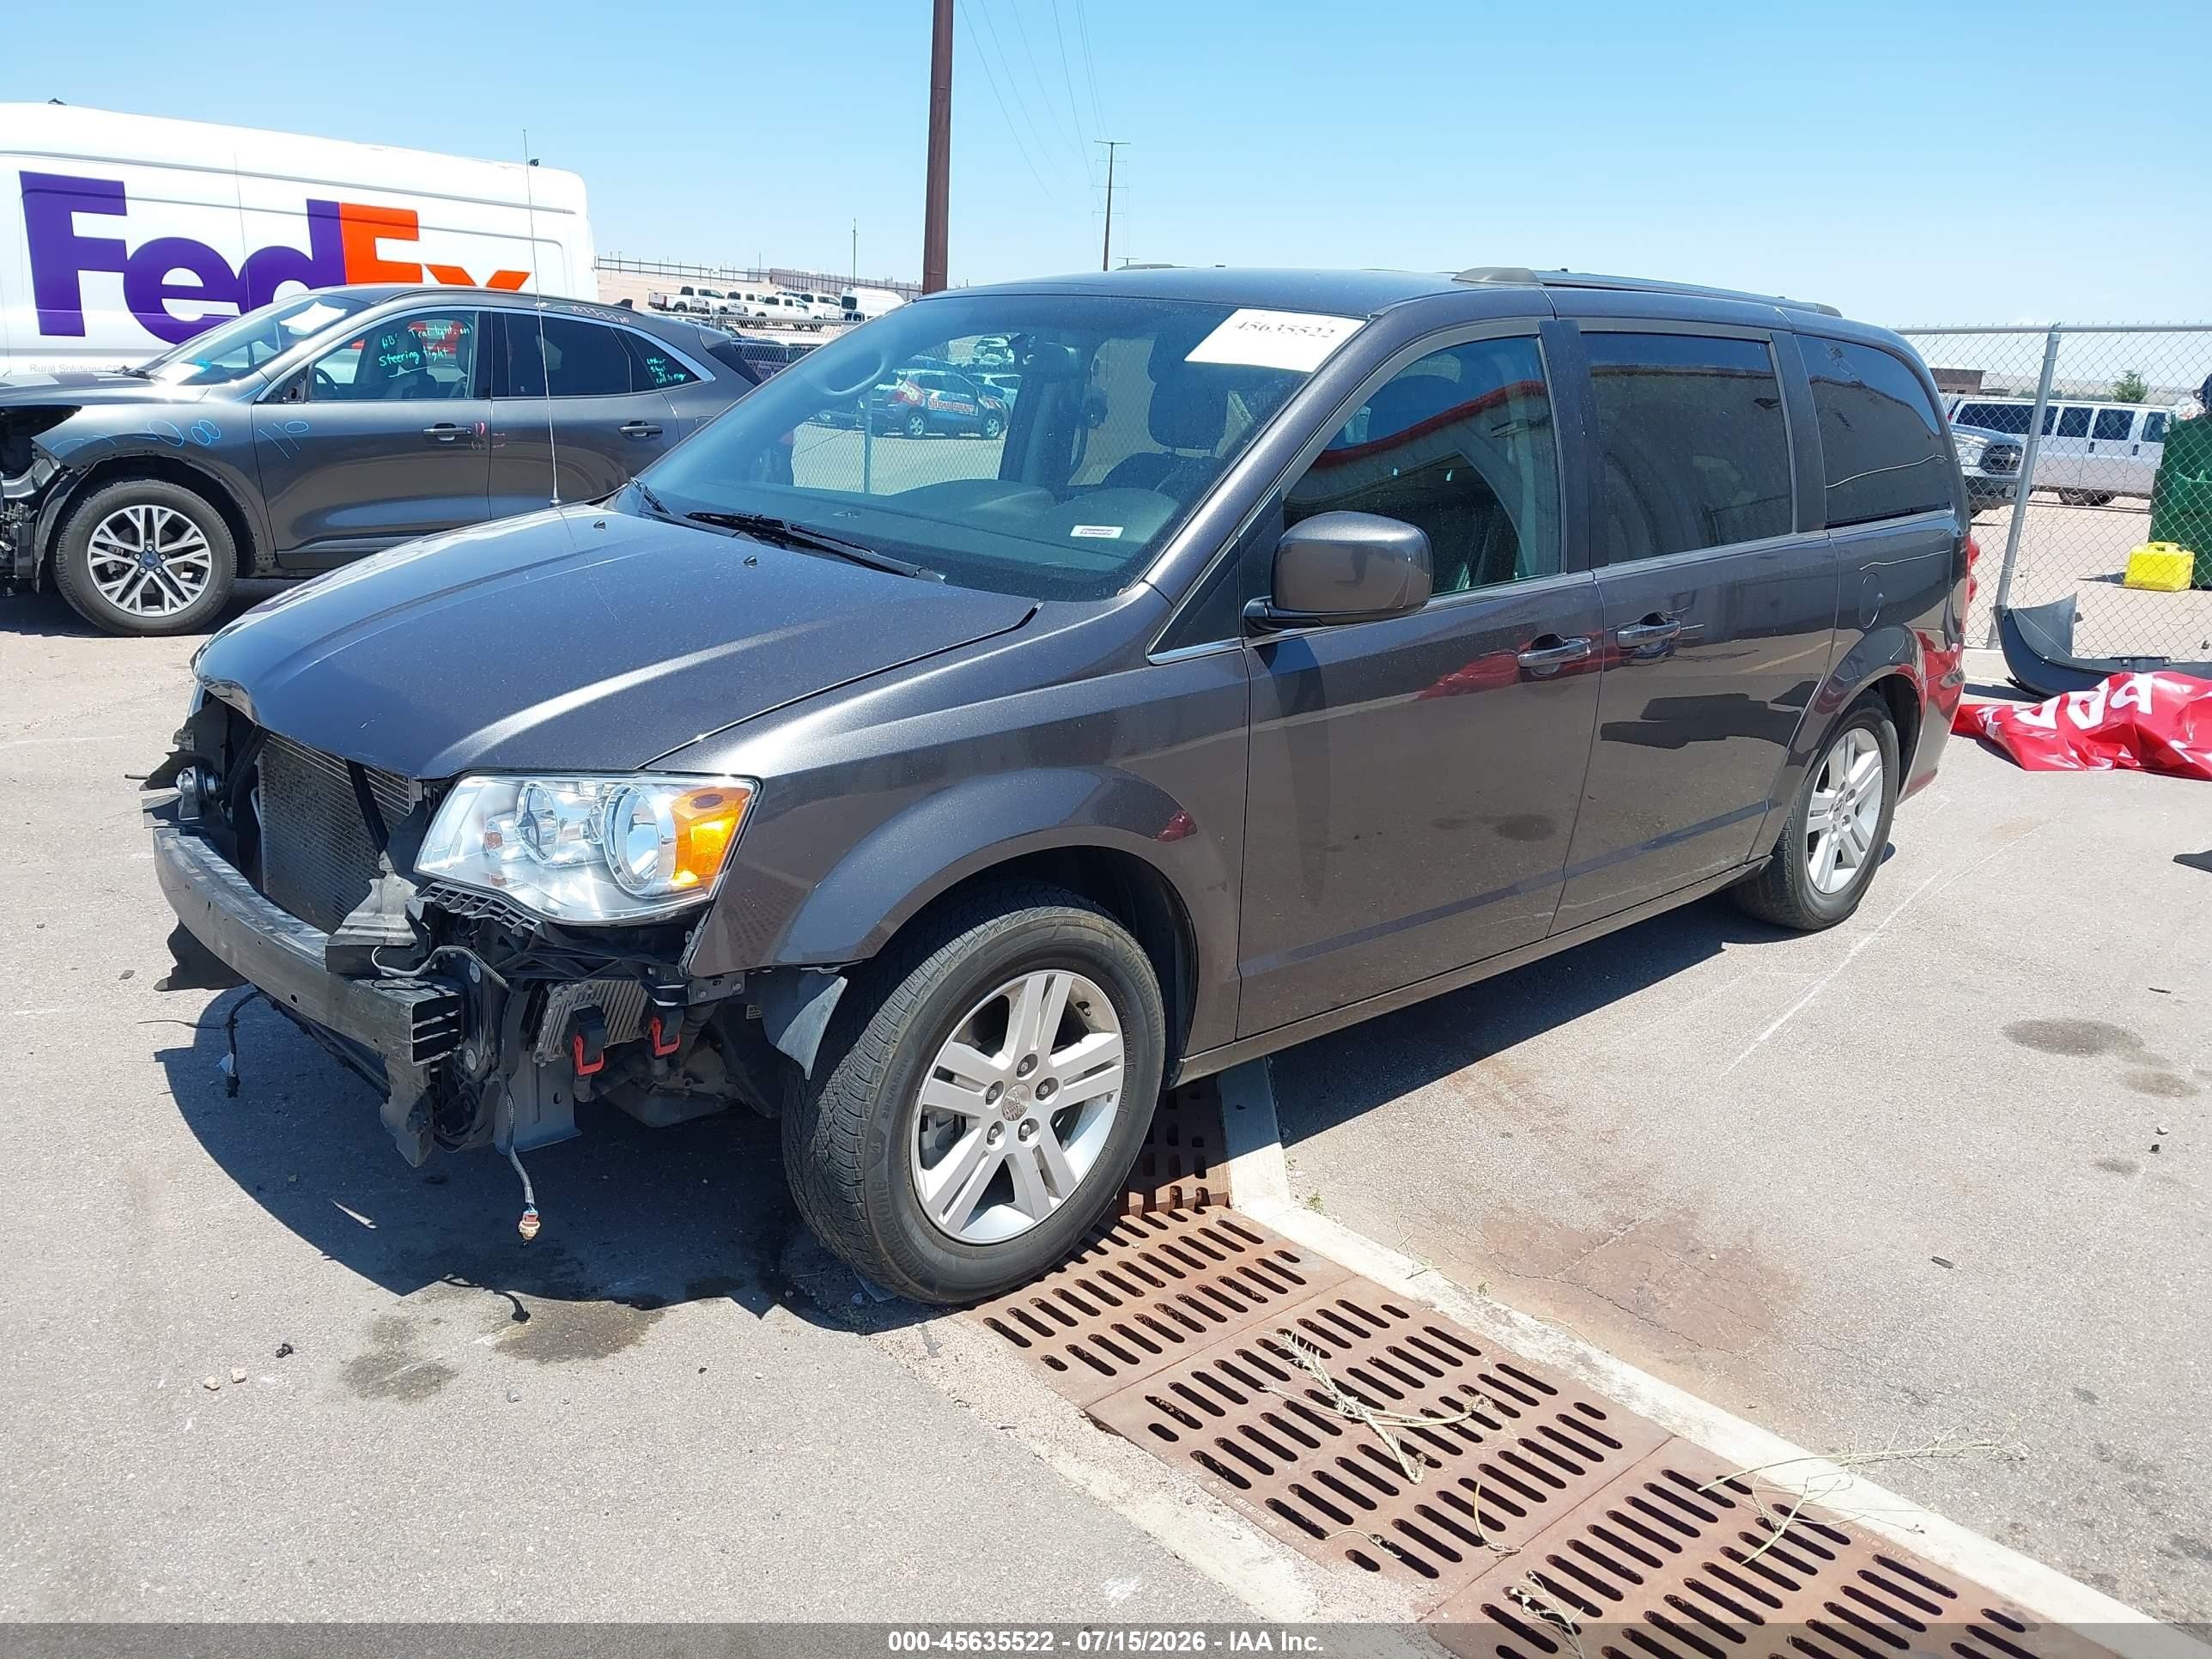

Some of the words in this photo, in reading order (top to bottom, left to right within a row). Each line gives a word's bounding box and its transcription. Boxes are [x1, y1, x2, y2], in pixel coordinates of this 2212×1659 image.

[378, 350, 420, 367] Steering
[422, 344, 449, 362] tight
[29, 363, 56, 373] Rural
